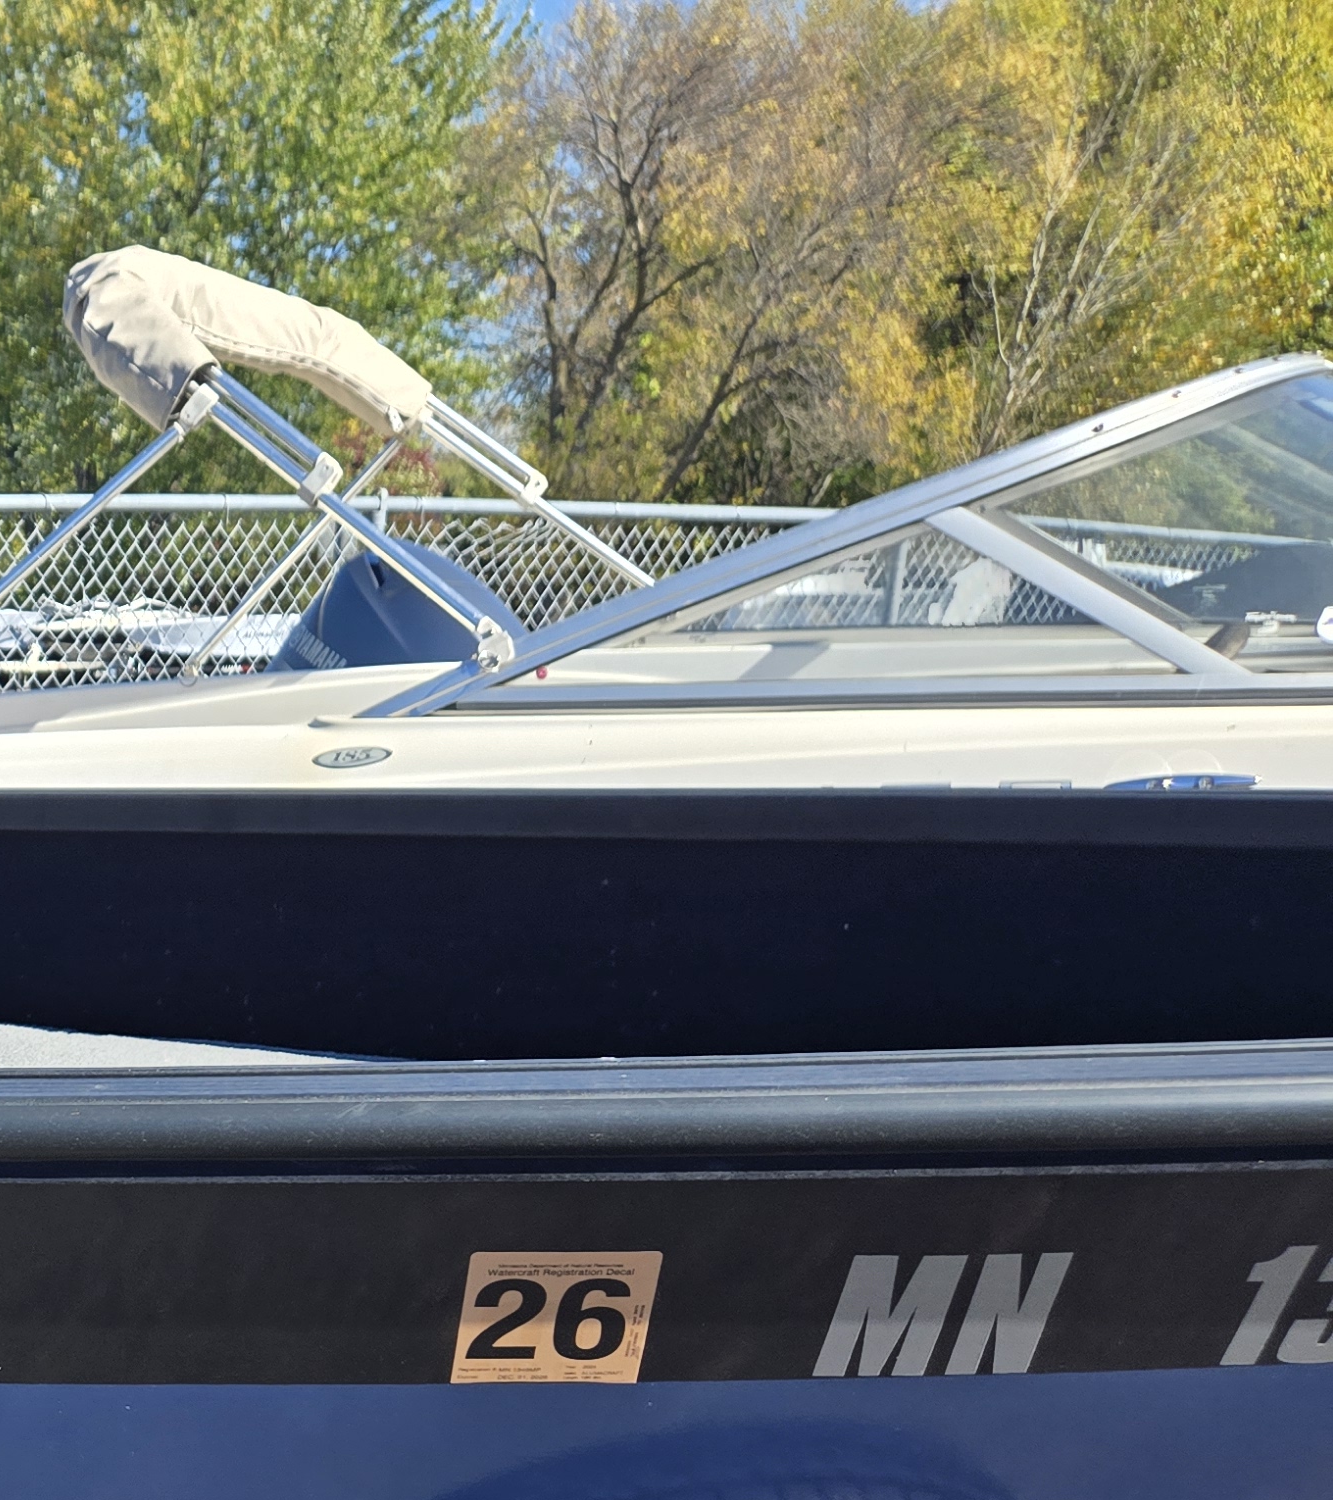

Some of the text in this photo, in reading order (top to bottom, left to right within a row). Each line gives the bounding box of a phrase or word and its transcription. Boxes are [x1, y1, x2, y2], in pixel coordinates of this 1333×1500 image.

[488, 1267, 636, 1278] Watercraft Registration Decal
[465, 1278, 631, 1360] 26
[812, 1252, 1073, 1377] MN
